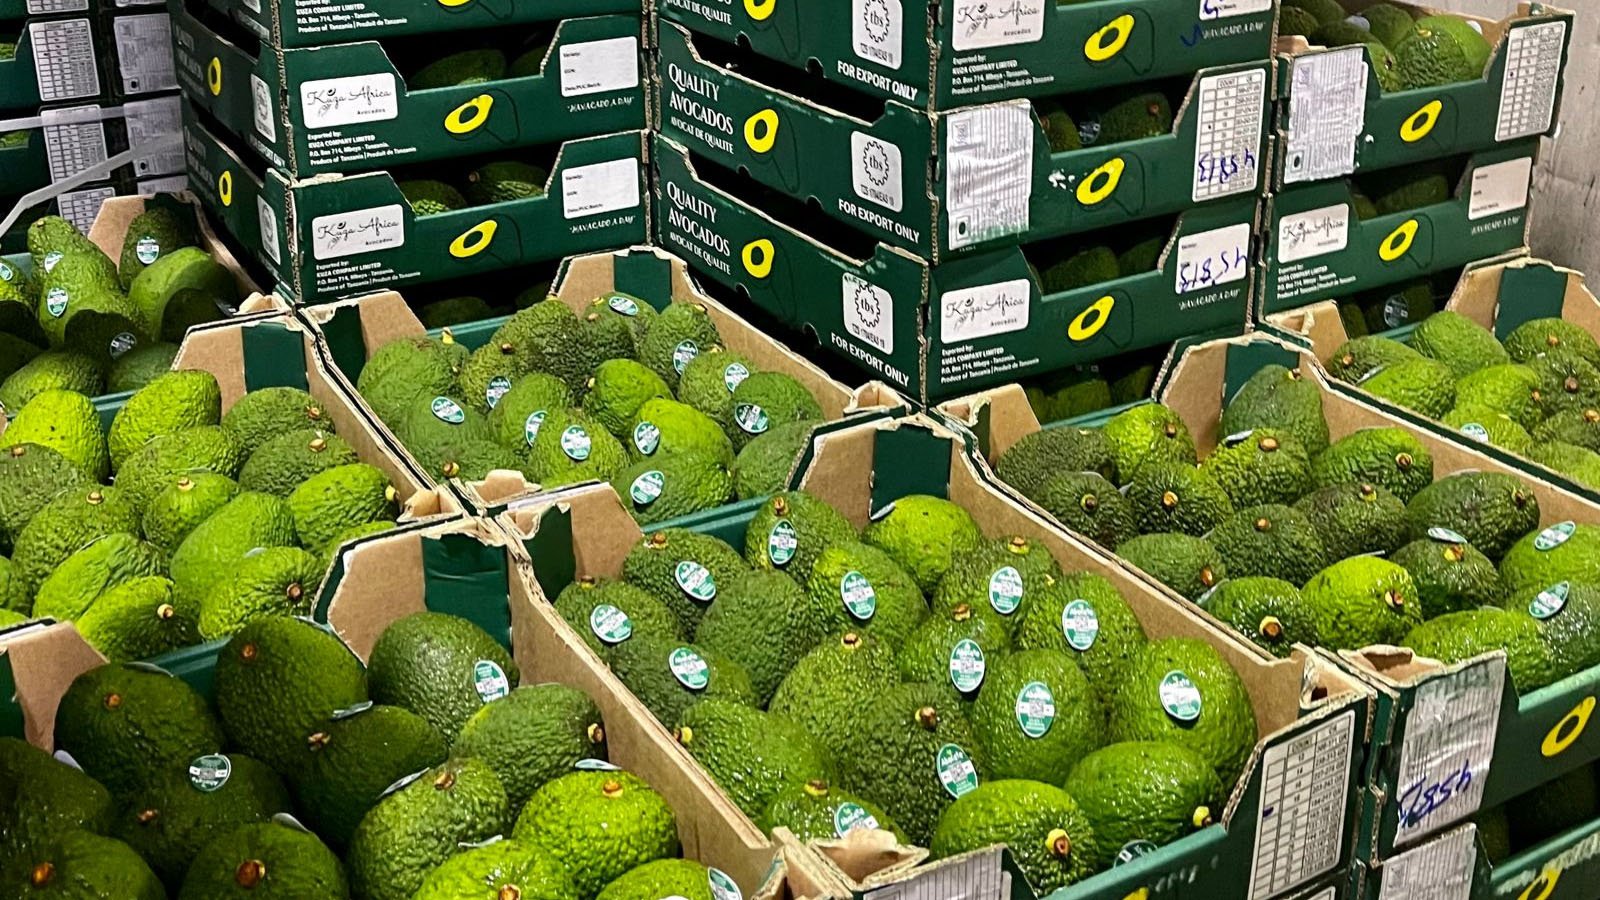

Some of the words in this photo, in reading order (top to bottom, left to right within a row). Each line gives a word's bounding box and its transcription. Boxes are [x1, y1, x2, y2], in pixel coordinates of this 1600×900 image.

[692, 2, 702, 15] DE
[702, 5, 732, 25] QUALITE
[870, 10, 884, 27] tbs
[957, 4, 997, 29] Kuza
[998, 0, 1039, 26] Africa
[307, 89, 346, 109] Kuza
[348, 85, 392, 106] Africa
[668, 63, 720, 102] QUALITY
[837, 60, 855, 78] FOR
[856, 67, 891, 92] EXPORT
[891, 81, 918, 101] ONLY
[669, 90, 734, 135] AVOCADOS
[671, 116, 695, 136] AVOCAT
[694, 129, 705, 141] DE
[704, 132, 734, 154] QUALITE
[869, 155, 883, 172] tbs
[667, 181, 717, 224] QUALITY
[838, 198, 857, 217] FOR
[857, 207, 894, 232] EXPORT
[894, 221, 920, 244] ONLY
[317, 221, 356, 240] Kuza
[358, 216, 399, 236] Africa
[668, 207, 731, 257] AVOCADOS
[669, 231, 693, 252] AVOCAT
[693, 247, 702, 258] DE
[702, 250, 731, 275] QUALITE
[861, 298, 875, 315] tbs
[945, 299, 982, 321] Kuza
[983, 293, 1024, 316] Africa
[831, 332, 849, 352] FOR
[849, 342, 884, 374] EXPORT
[885, 364, 910, 387] ONLY
